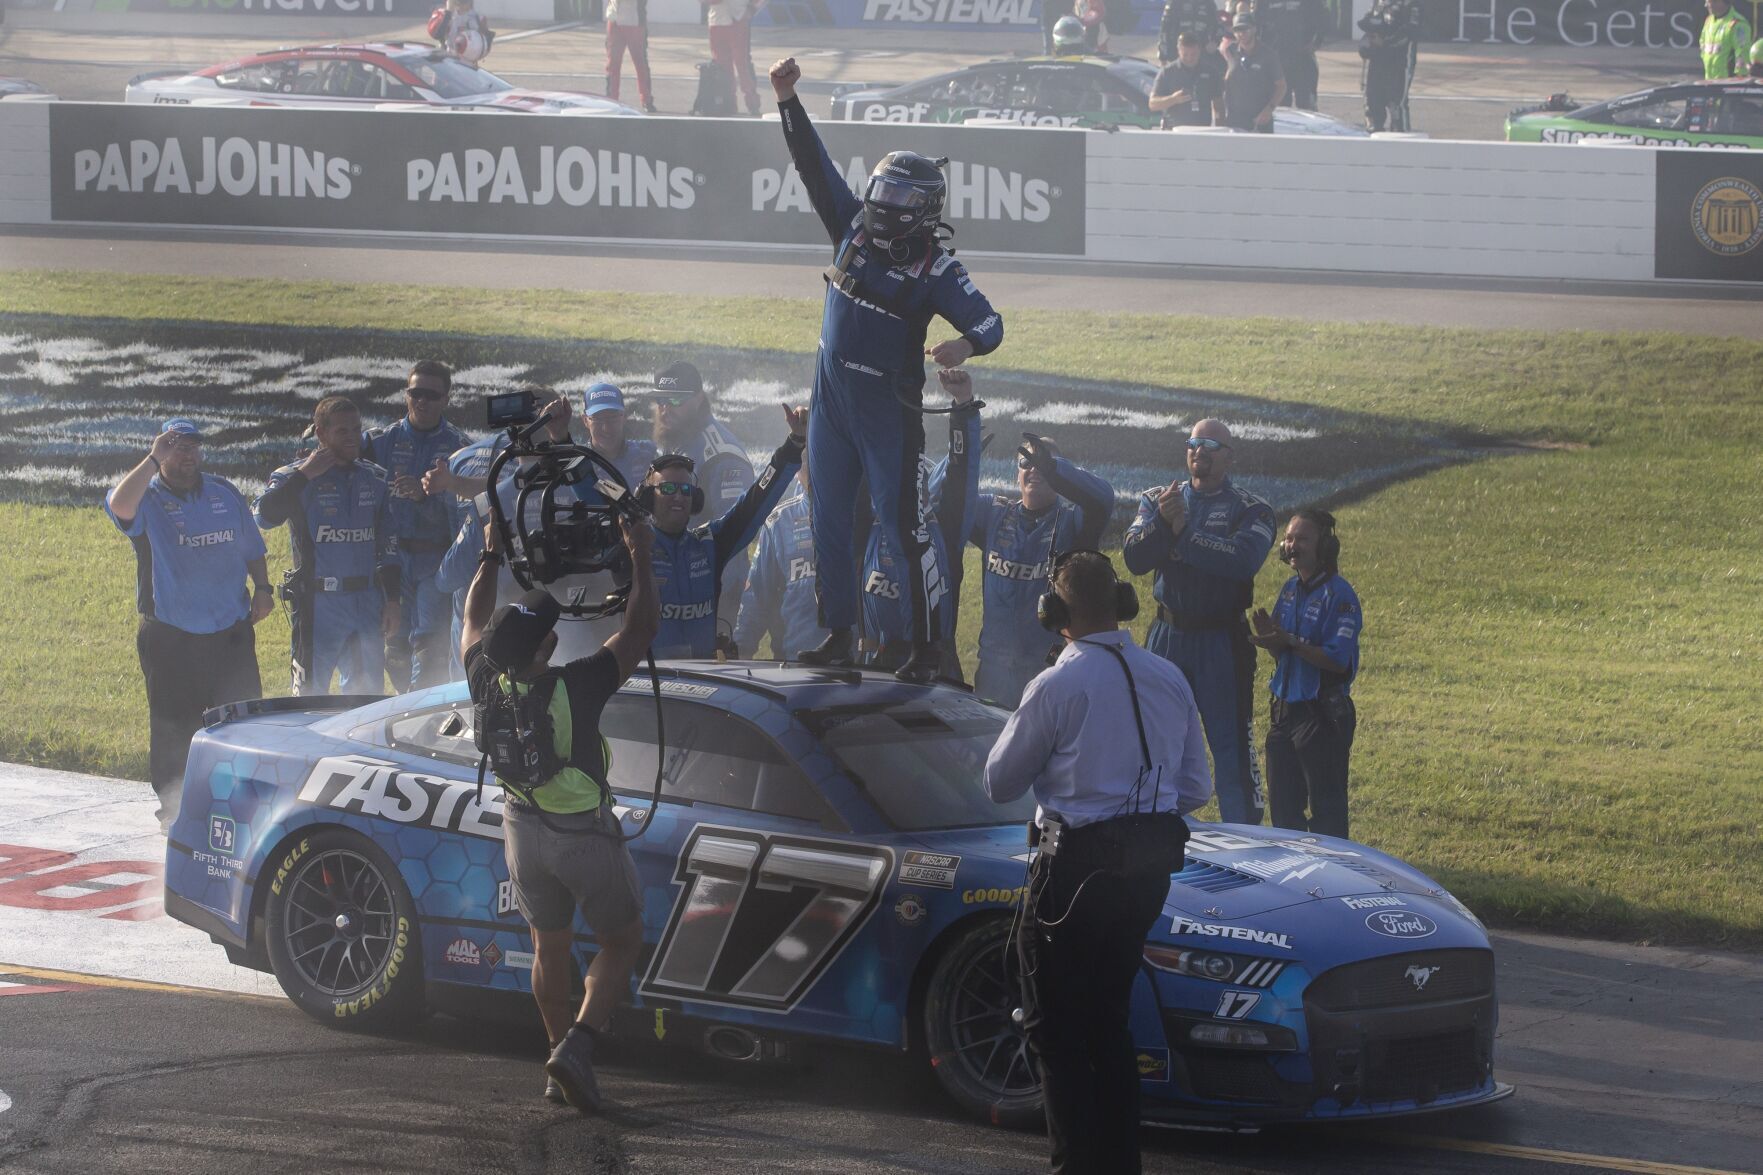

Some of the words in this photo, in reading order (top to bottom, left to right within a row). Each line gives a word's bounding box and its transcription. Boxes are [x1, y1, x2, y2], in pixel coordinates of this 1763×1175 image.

[862, 0, 1037, 25] FASTENAL
[1451, 0, 1536, 45] He
[1555, 0, 1694, 50] Gets
[844, 101, 930, 125] Leaf
[74, 137, 192, 194] PAPA
[195, 136, 353, 200] JOHNS
[406, 146, 529, 205] PAPA
[532, 145, 696, 210] JOHNS
[751, 156, 868, 214] PAA
[949, 160, 1052, 222] HNS
[658, 376, 679, 386] RFK
[316, 525, 375, 544] FASTENA
[1190, 532, 1237, 555] FASTENAL
[988, 550, 1050, 581] FASTENA
[660, 599, 713, 620] STENAL
[297, 754, 506, 840] FASTE
[193, 851, 218, 865] FIFTH
[220, 855, 244, 870] THIRD
[207, 865, 231, 879] BANK
[271, 838, 312, 896] EAGLE
[918, 855, 952, 868] NASCAR
[907, 867, 921, 878] CUP
[920, 869, 947, 881] SERIES
[962, 888, 1018, 905] GOOD
[1340, 895, 1407, 911] FASTENAL
[640, 824, 894, 1012] 17
[1382, 913, 1428, 936] Ford
[1170, 916, 1292, 950] FASTENAL
[446, 938, 480, 958] MAC
[447, 955, 480, 965] TOOLS
[1214, 989, 1263, 1021] 17
